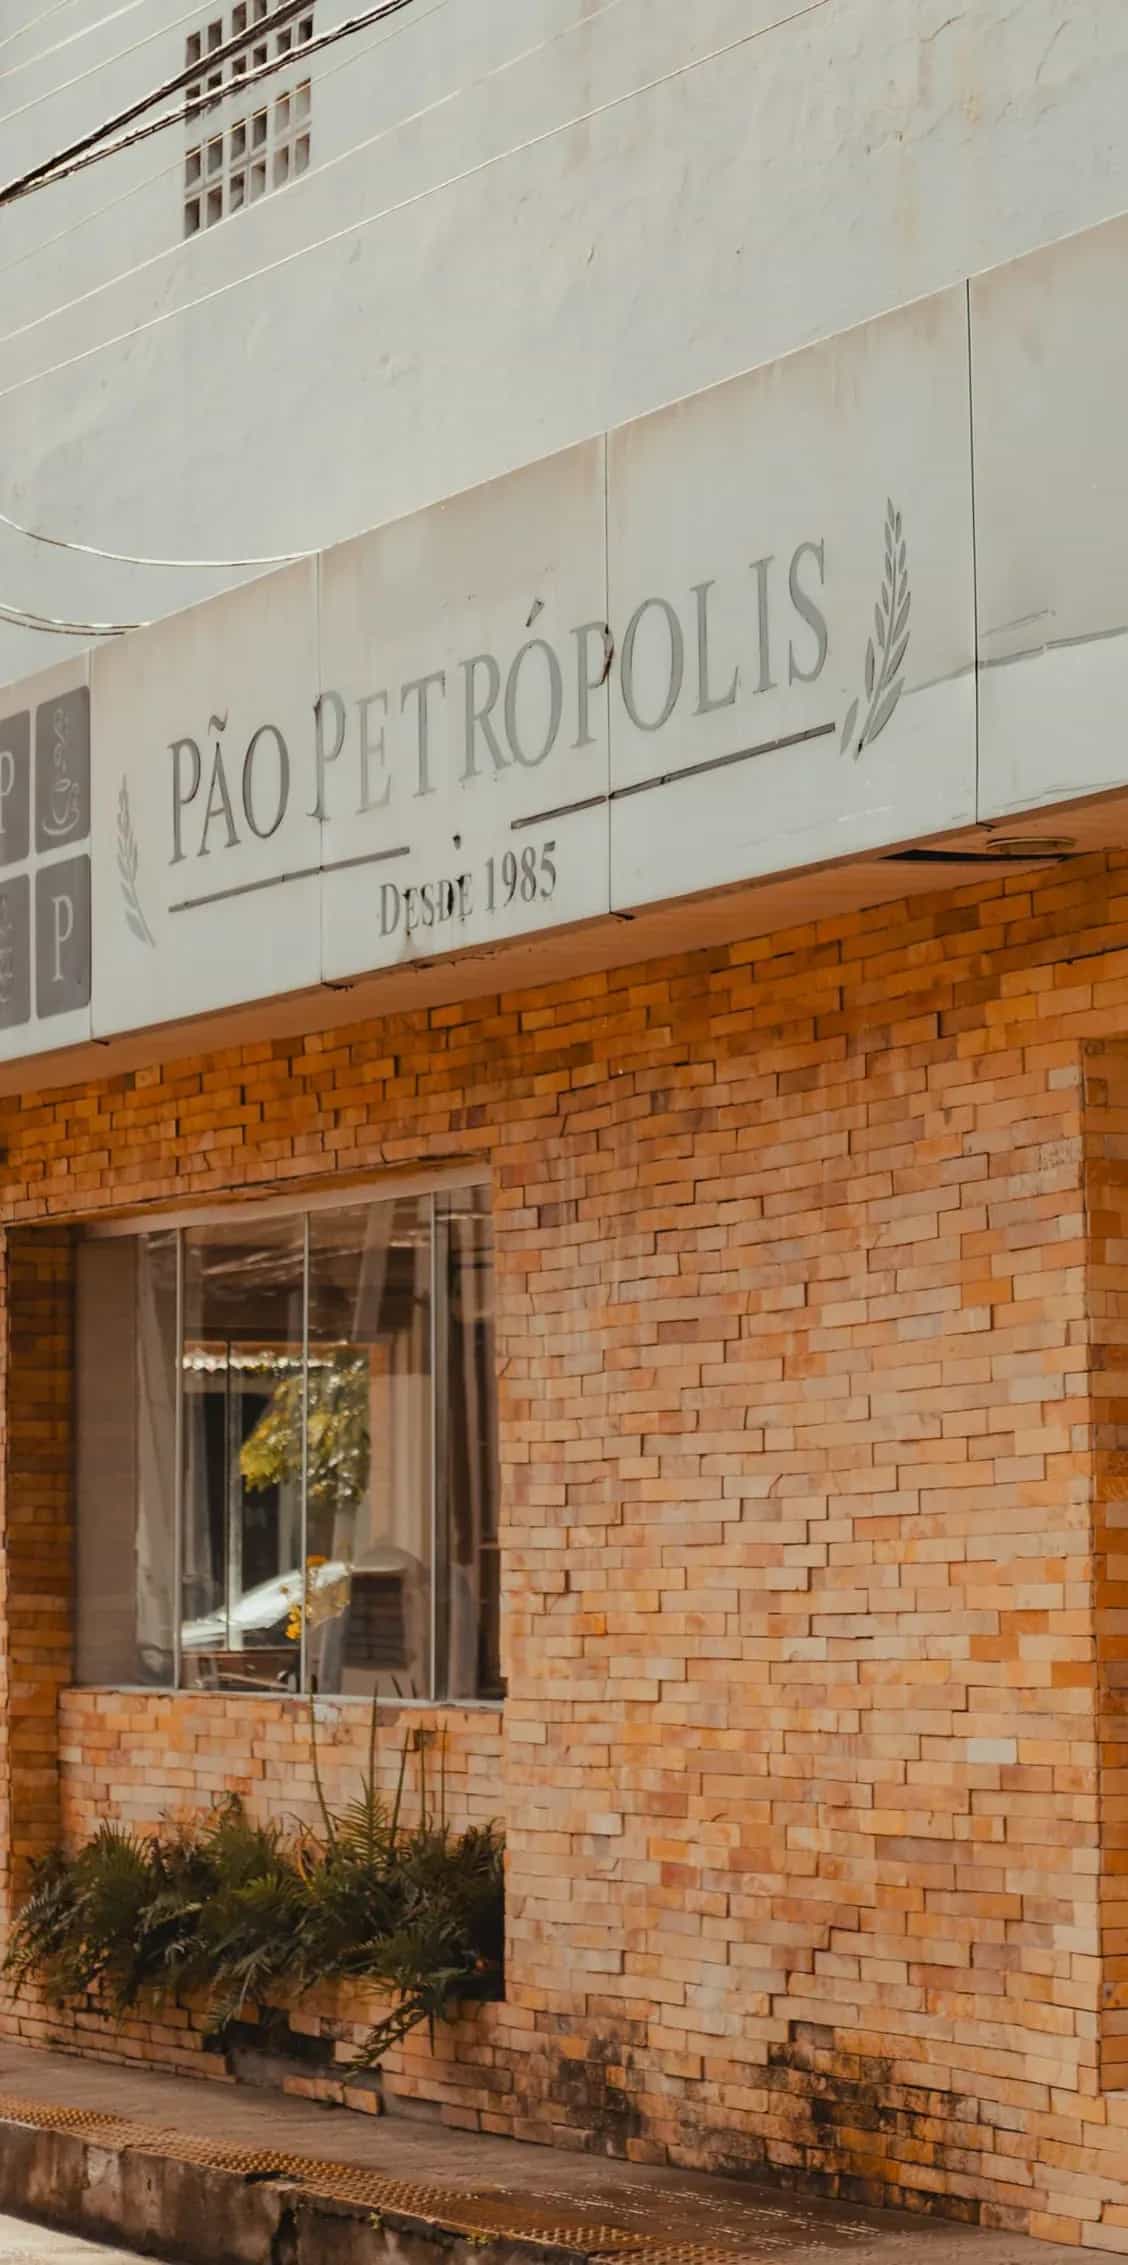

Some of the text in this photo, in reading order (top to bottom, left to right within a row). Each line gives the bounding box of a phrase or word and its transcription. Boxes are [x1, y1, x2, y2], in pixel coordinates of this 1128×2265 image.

[168, 537, 828, 866] PÃO PETRÓPOLIS
[379, 840, 557, 937] DESDE 1985
[51, 895, 74, 982] P
